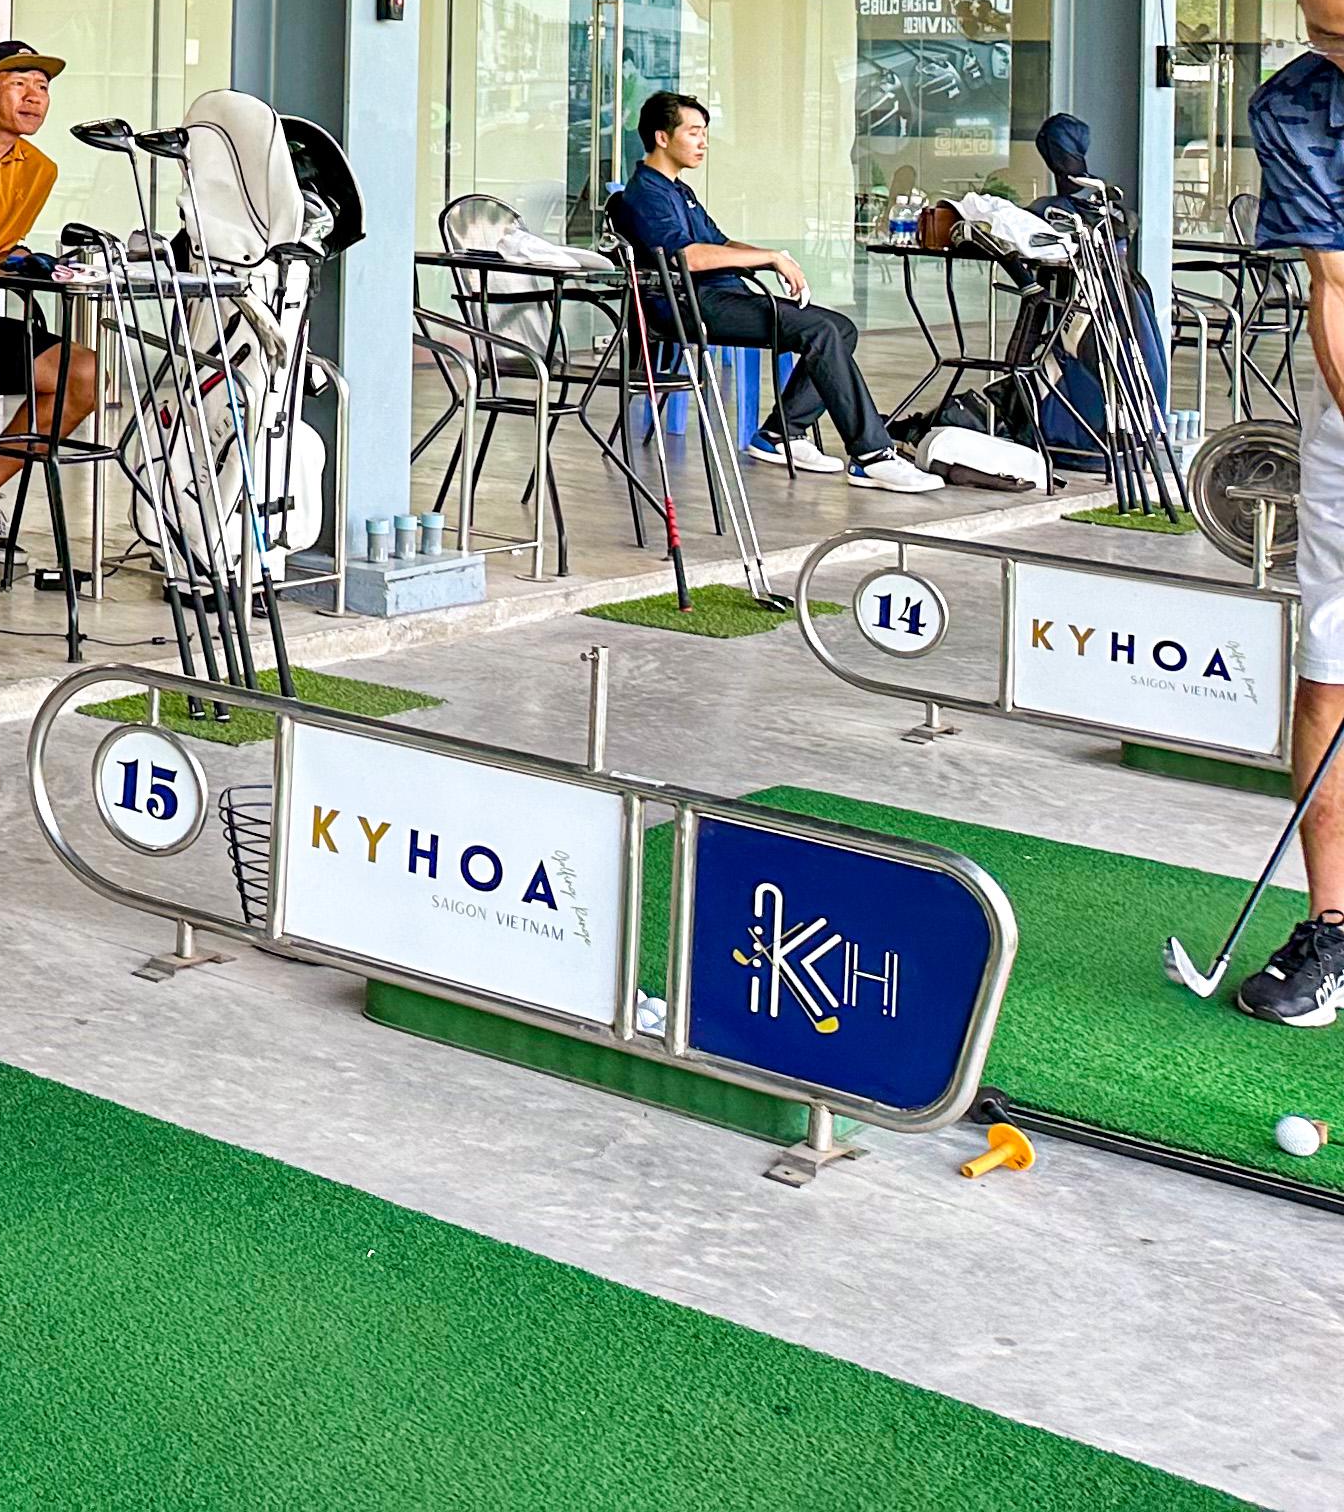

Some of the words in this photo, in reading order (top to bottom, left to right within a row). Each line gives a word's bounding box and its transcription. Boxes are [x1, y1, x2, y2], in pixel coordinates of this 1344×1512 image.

[872, 593, 927, 637] 14
[1031, 618, 1233, 682] KYHOA
[1129, 674, 1176, 692] SAIGON
[1181, 683, 1238, 703] VIETNAM
[114, 758, 178, 820] 15
[311, 805, 558, 911] KYHOA
[430, 894, 487, 920] SAIGON
[495, 910, 564, 941] VIETNAM
